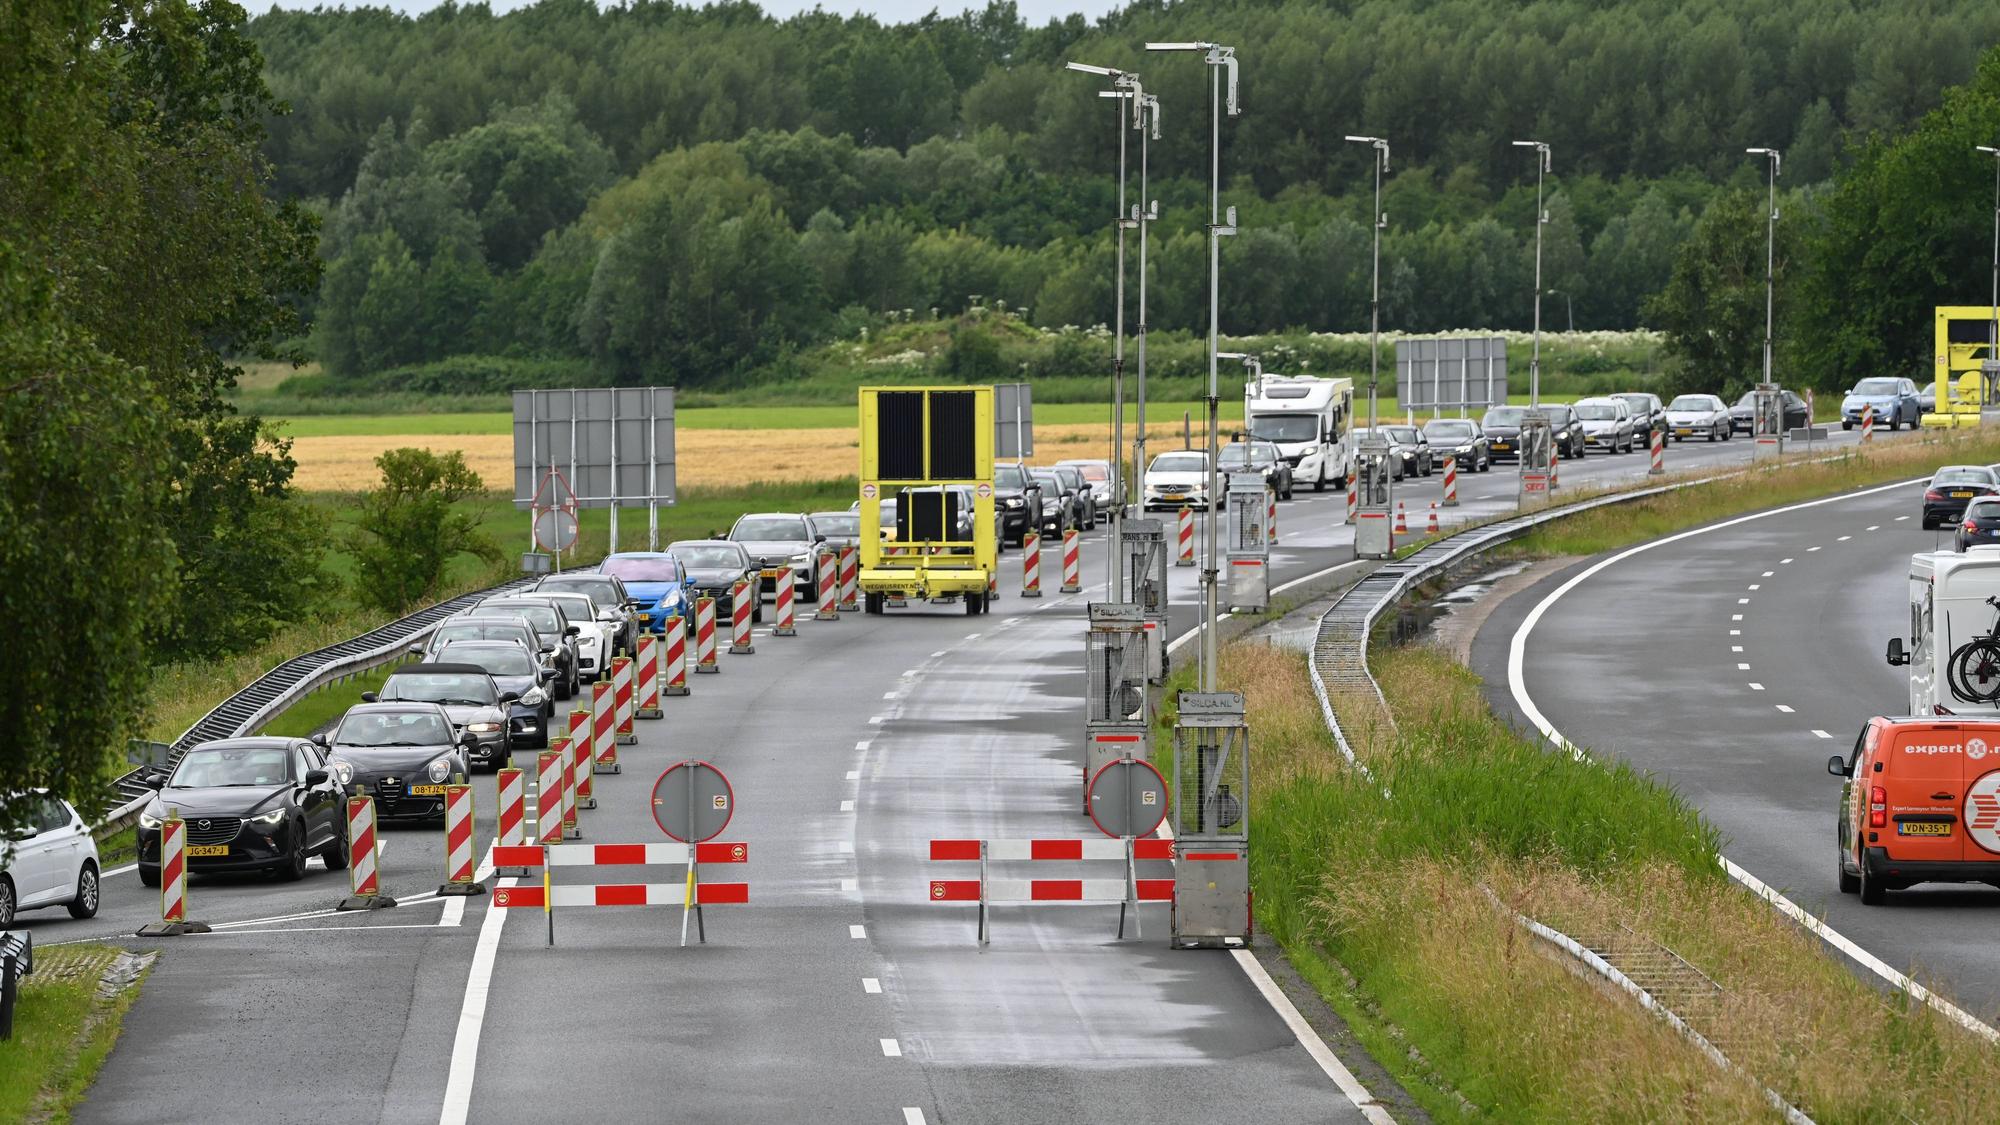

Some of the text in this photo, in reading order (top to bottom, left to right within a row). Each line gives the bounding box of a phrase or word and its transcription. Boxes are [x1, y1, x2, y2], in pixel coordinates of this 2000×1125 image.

[1190, 699, 1232, 708] SILCA.NL
[1905, 744, 1963, 755] expert
[414, 786, 447, 794] 08-TJZ-9
[1905, 824, 1948, 833] VDN-35-T
[190, 847, 224, 856] JG-347-J
